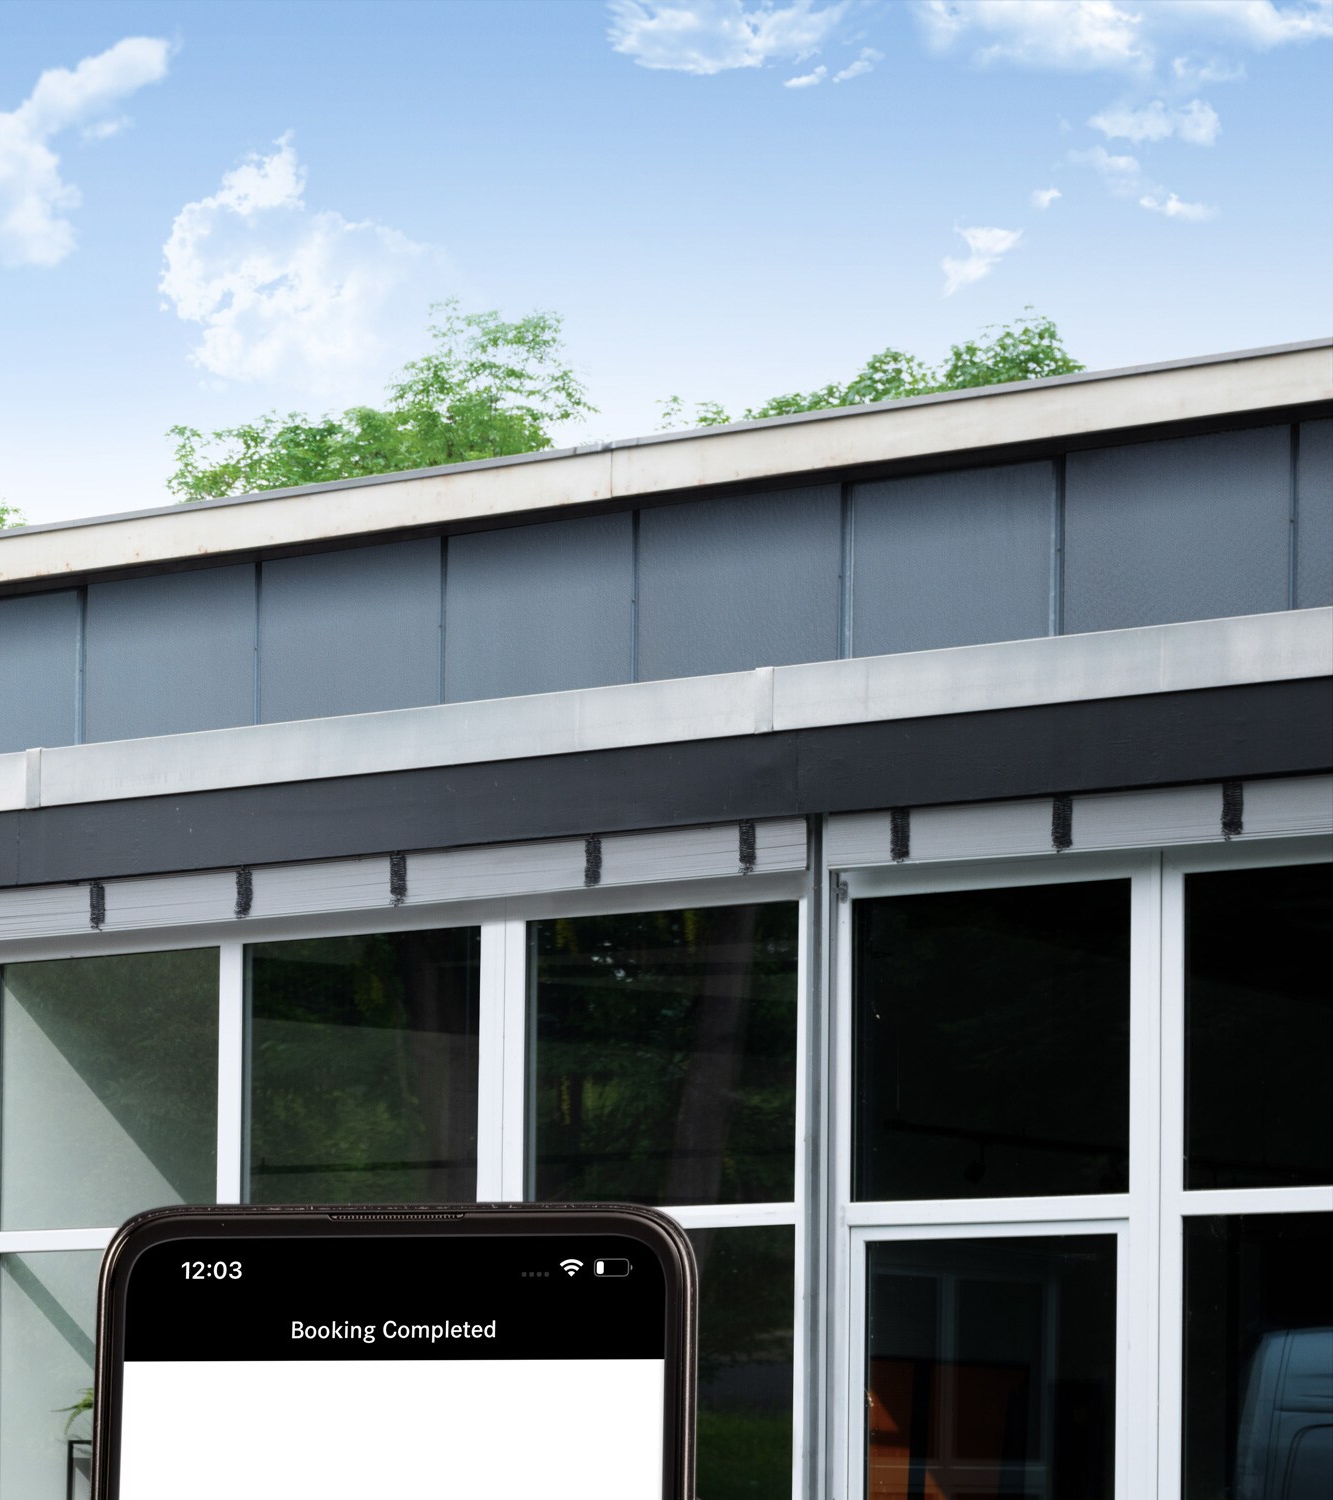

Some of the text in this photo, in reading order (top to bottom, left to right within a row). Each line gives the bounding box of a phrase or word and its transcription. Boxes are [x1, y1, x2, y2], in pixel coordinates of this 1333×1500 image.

[181, 1261, 243, 1280] 12:03
[291, 1319, 497, 1344] Booking Completed
